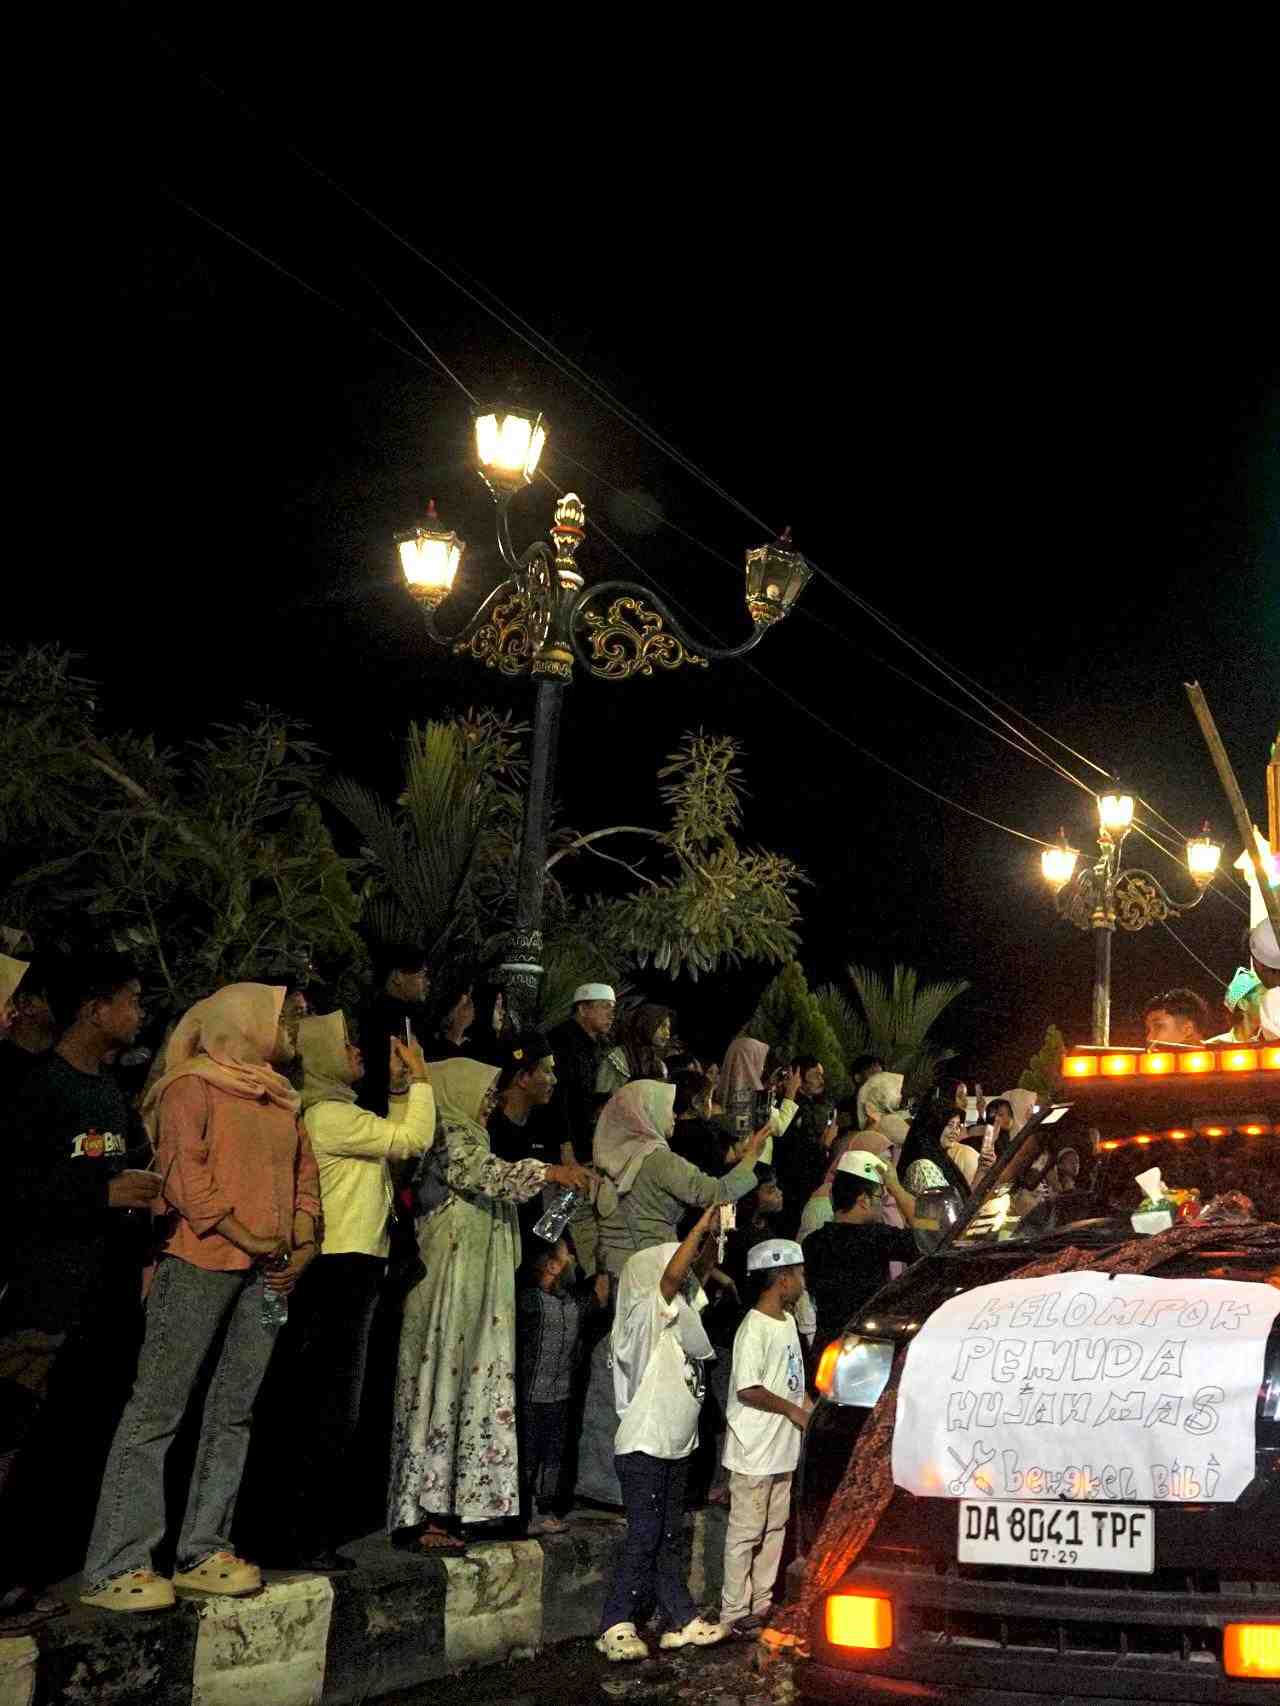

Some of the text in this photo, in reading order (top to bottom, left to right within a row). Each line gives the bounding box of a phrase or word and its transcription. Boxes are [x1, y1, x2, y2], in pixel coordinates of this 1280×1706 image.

[968, 1291, 1249, 1330] KELOMPOK
[951, 1336, 1188, 1383] PEMUDA
[965, 1505, 1146, 1548] DA 8041 TPF
